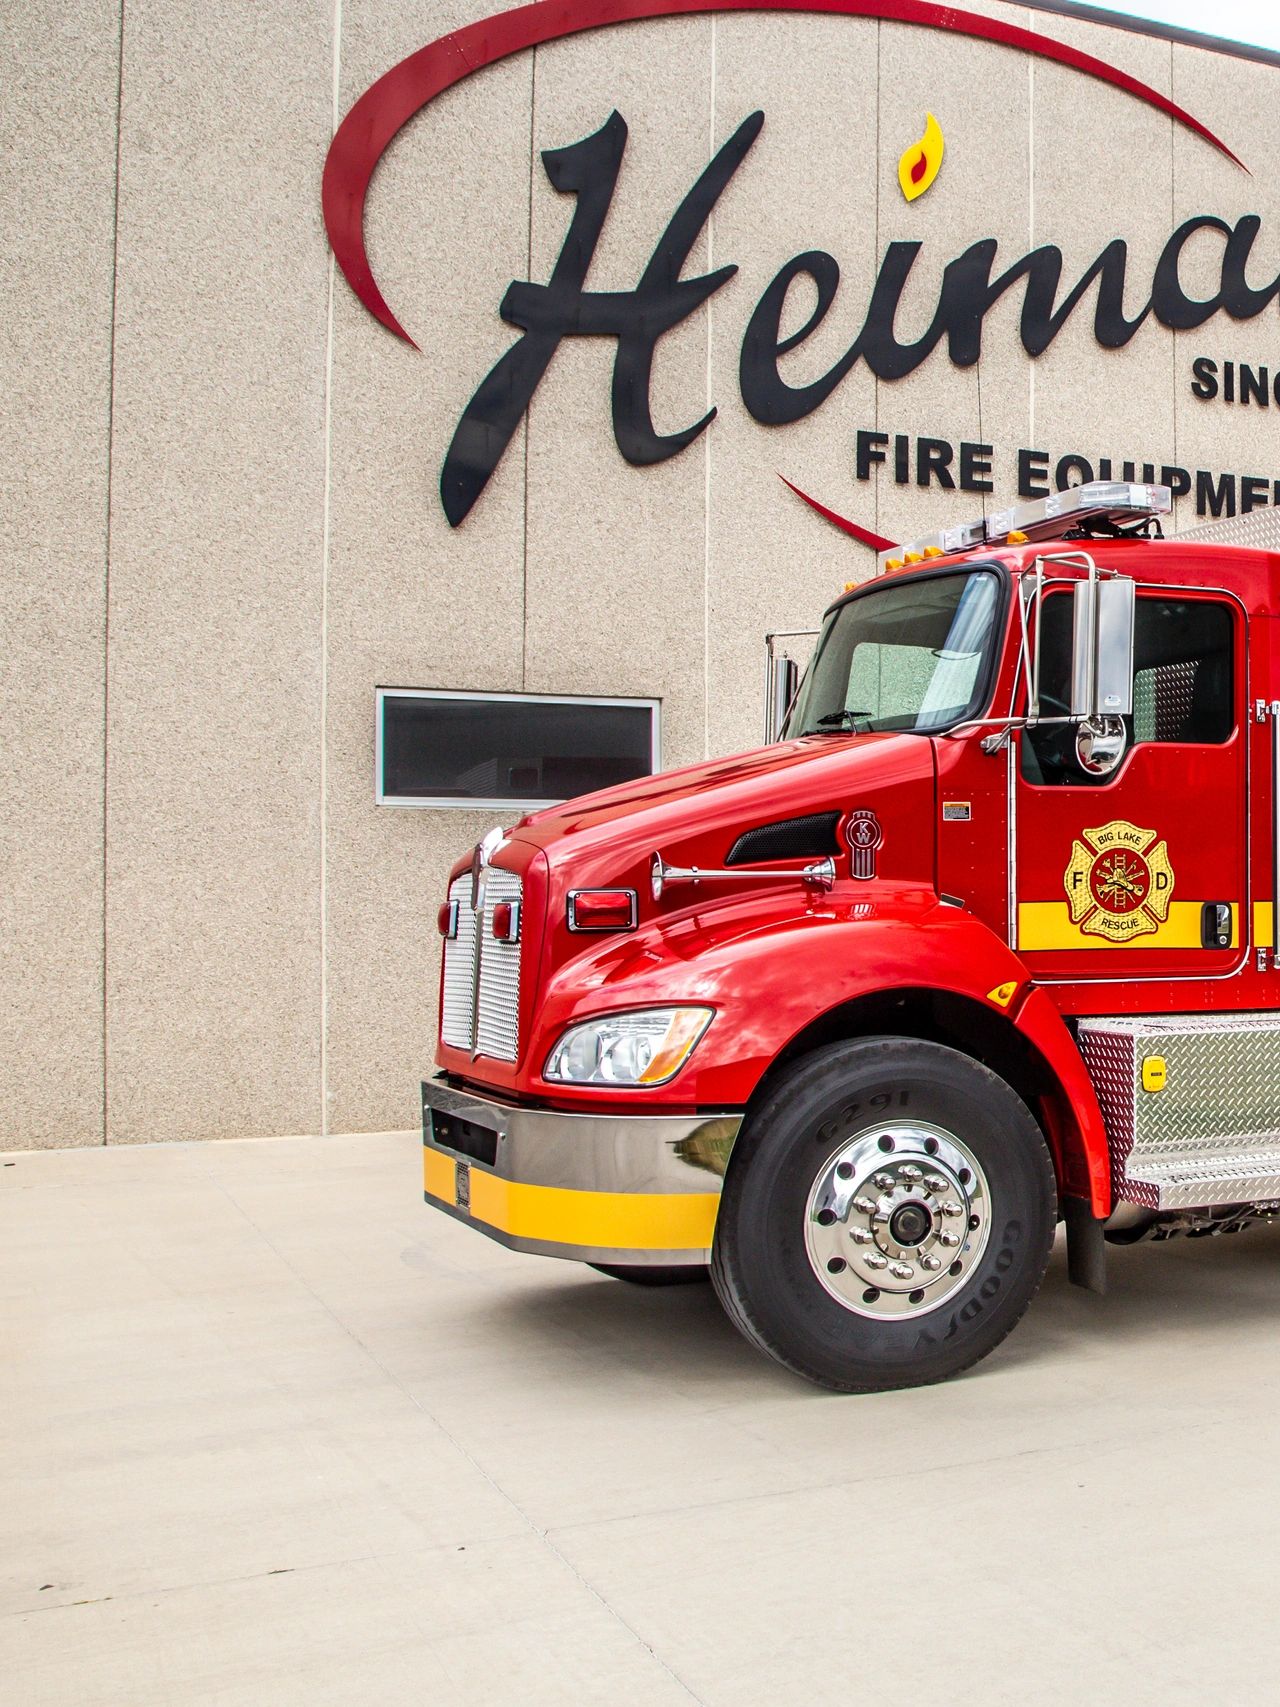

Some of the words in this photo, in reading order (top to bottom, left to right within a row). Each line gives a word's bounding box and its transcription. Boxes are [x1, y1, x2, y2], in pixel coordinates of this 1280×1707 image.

[856, 431, 994, 495] FIRE
[1097, 832, 1114, 845] BIG
[1117, 831, 1142, 845] LAKE
[1073, 871, 1084, 890] F
[1156, 872, 1168, 890] D
[1101, 917, 1139, 930] RESCUE
